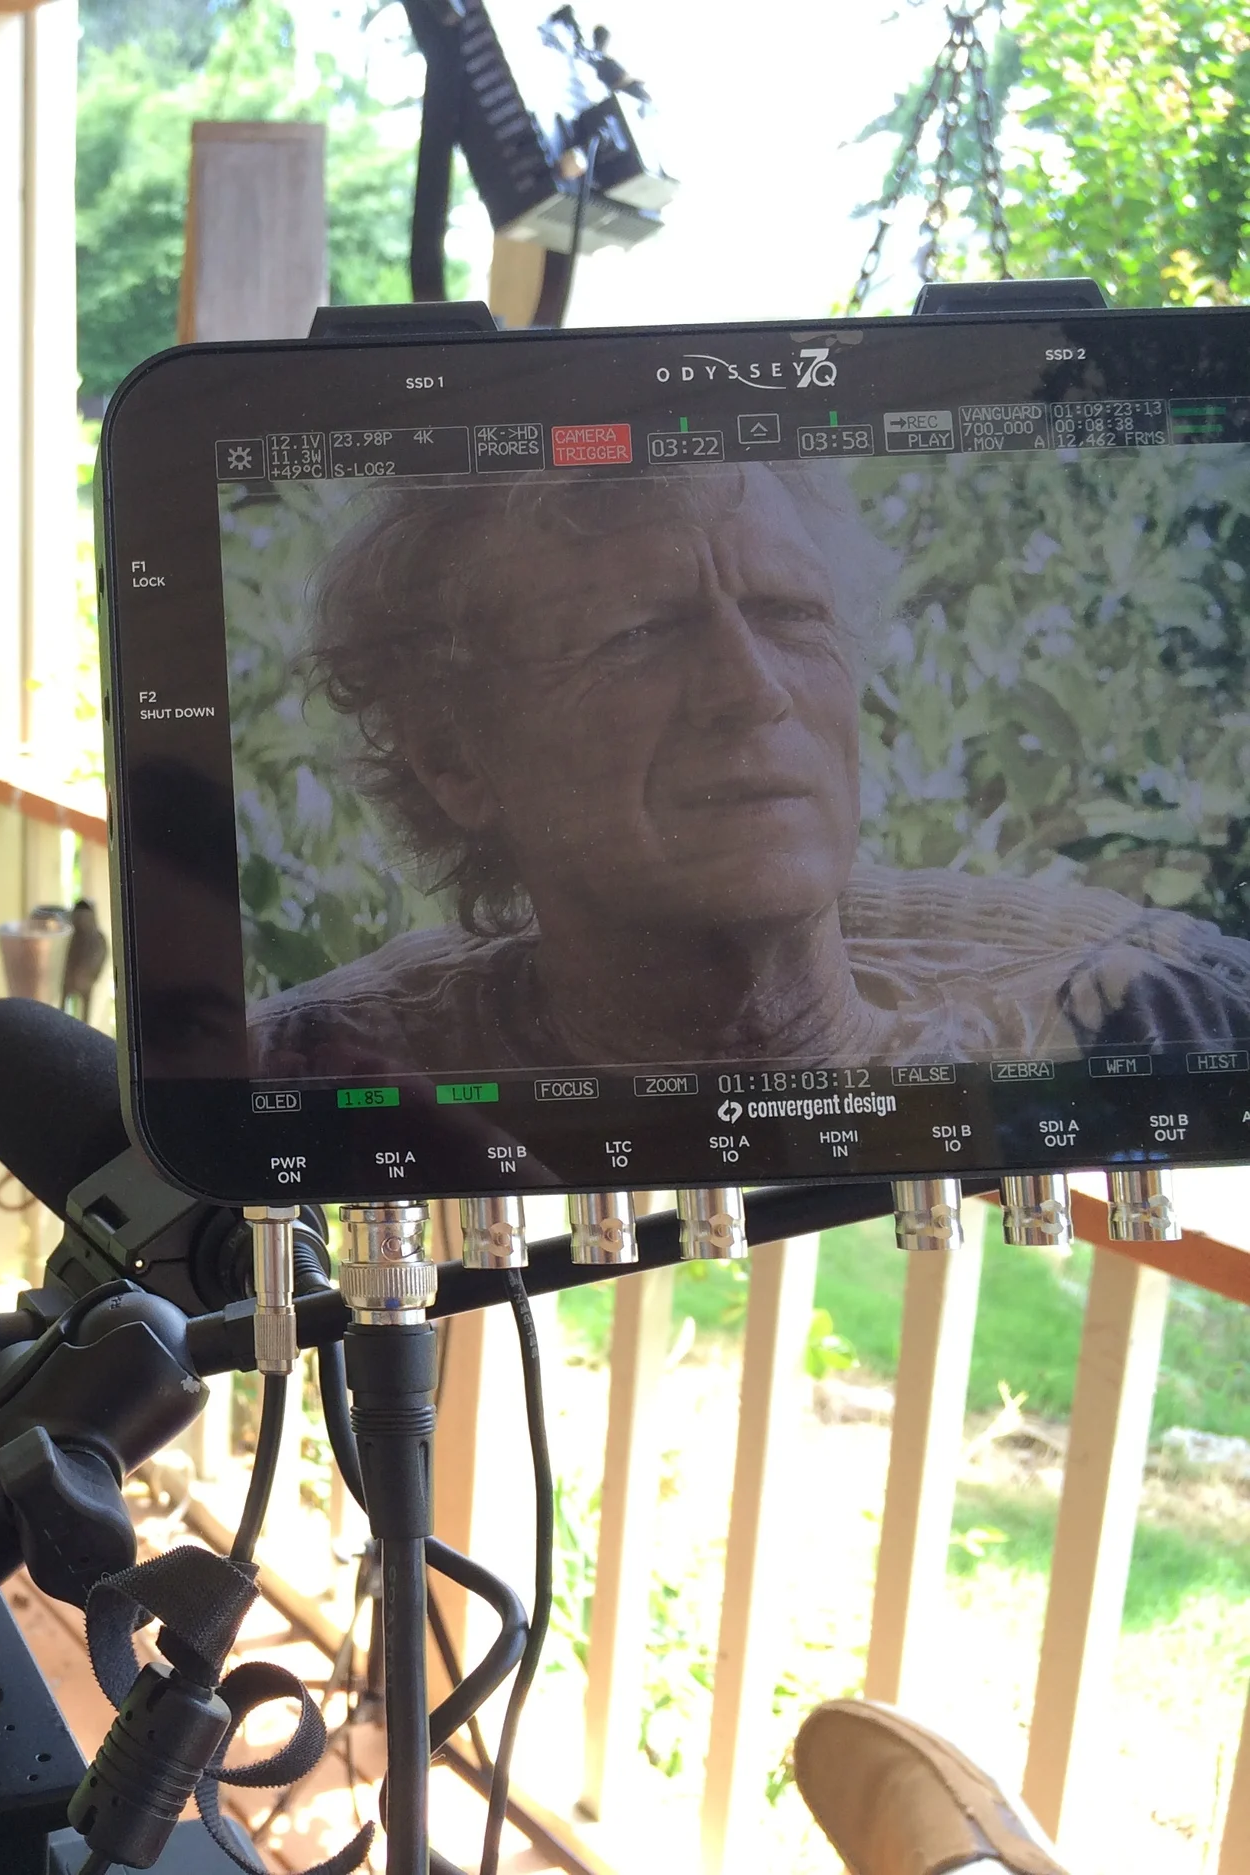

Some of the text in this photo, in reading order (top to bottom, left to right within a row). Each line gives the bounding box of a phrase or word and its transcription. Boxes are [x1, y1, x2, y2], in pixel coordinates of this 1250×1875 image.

[1045, 348, 1086, 361] SSD 2
[405, 376, 444, 389] SSD 1
[961, 405, 1042, 422] VANGUARD
[1053, 402, 1162, 418] 01:09:23:13
[908, 415, 938, 429] REC
[1055, 417, 1135, 433] 00:08:38
[270, 434, 321, 450] 12.1V
[333, 431, 434, 448] 23.98P 4K
[555, 428, 617, 444] CAMERA
[801, 431, 868, 451] 03:58
[908, 432, 950, 448] PLAY
[1034, 437, 1046, 449] A
[1124, 430, 1166, 446] FRMS
[478, 440, 540, 457] PRORES
[556, 444, 629, 461] TRIGGER
[651, 437, 720, 457] 03:22
[271, 449, 322, 465] 11.3W
[334, 461, 396, 477] S-LOG2
[131, 561, 146, 573] F1
[132, 576, 166, 588] LOCK
[139, 691, 157, 703] F2
[140, 706, 215, 720] SHUT DOWN
[1106, 1058, 1137, 1074] WFM
[1197, 1054, 1239, 1070] HIST
[897, 1067, 949, 1083] FALSE
[996, 1062, 1050, 1079] ZEBRA
[645, 1077, 688, 1094] ZOOM
[717, 1068, 871, 1094] 01:18:03:12
[452, 1085, 483, 1101] LUT
[540, 1080, 593, 1097] FOCUS
[254, 1094, 297, 1110] OLED
[344, 1090, 385, 1106] 1.85
[747, 1092, 897, 1120] convergent design
[1039, 1119, 1080, 1133] SDI A
[1150, 1114, 1189, 1128] SDI B
[819, 1130, 859, 1144] HDMI
[932, 1124, 972, 1138] SDI B
[1154, 1128, 1186, 1141] OUT
[605, 1140, 632, 1154] LTC
[709, 1135, 750, 1149] SDI A
[944, 1139, 961, 1152] IO
[1044, 1134, 1076, 1147] OUT
[375, 1151, 416, 1165] SDI A
[487, 1145, 527, 1159] SDI B
[722, 1150, 739, 1163] IO
[832, 1145, 849, 1158] IN
[270, 1156, 307, 1170] PWR
[499, 1160, 516, 1173] IN
[612, 1155, 628, 1168] IO
[277, 1171, 302, 1184] ON
[388, 1166, 405, 1179] IN
